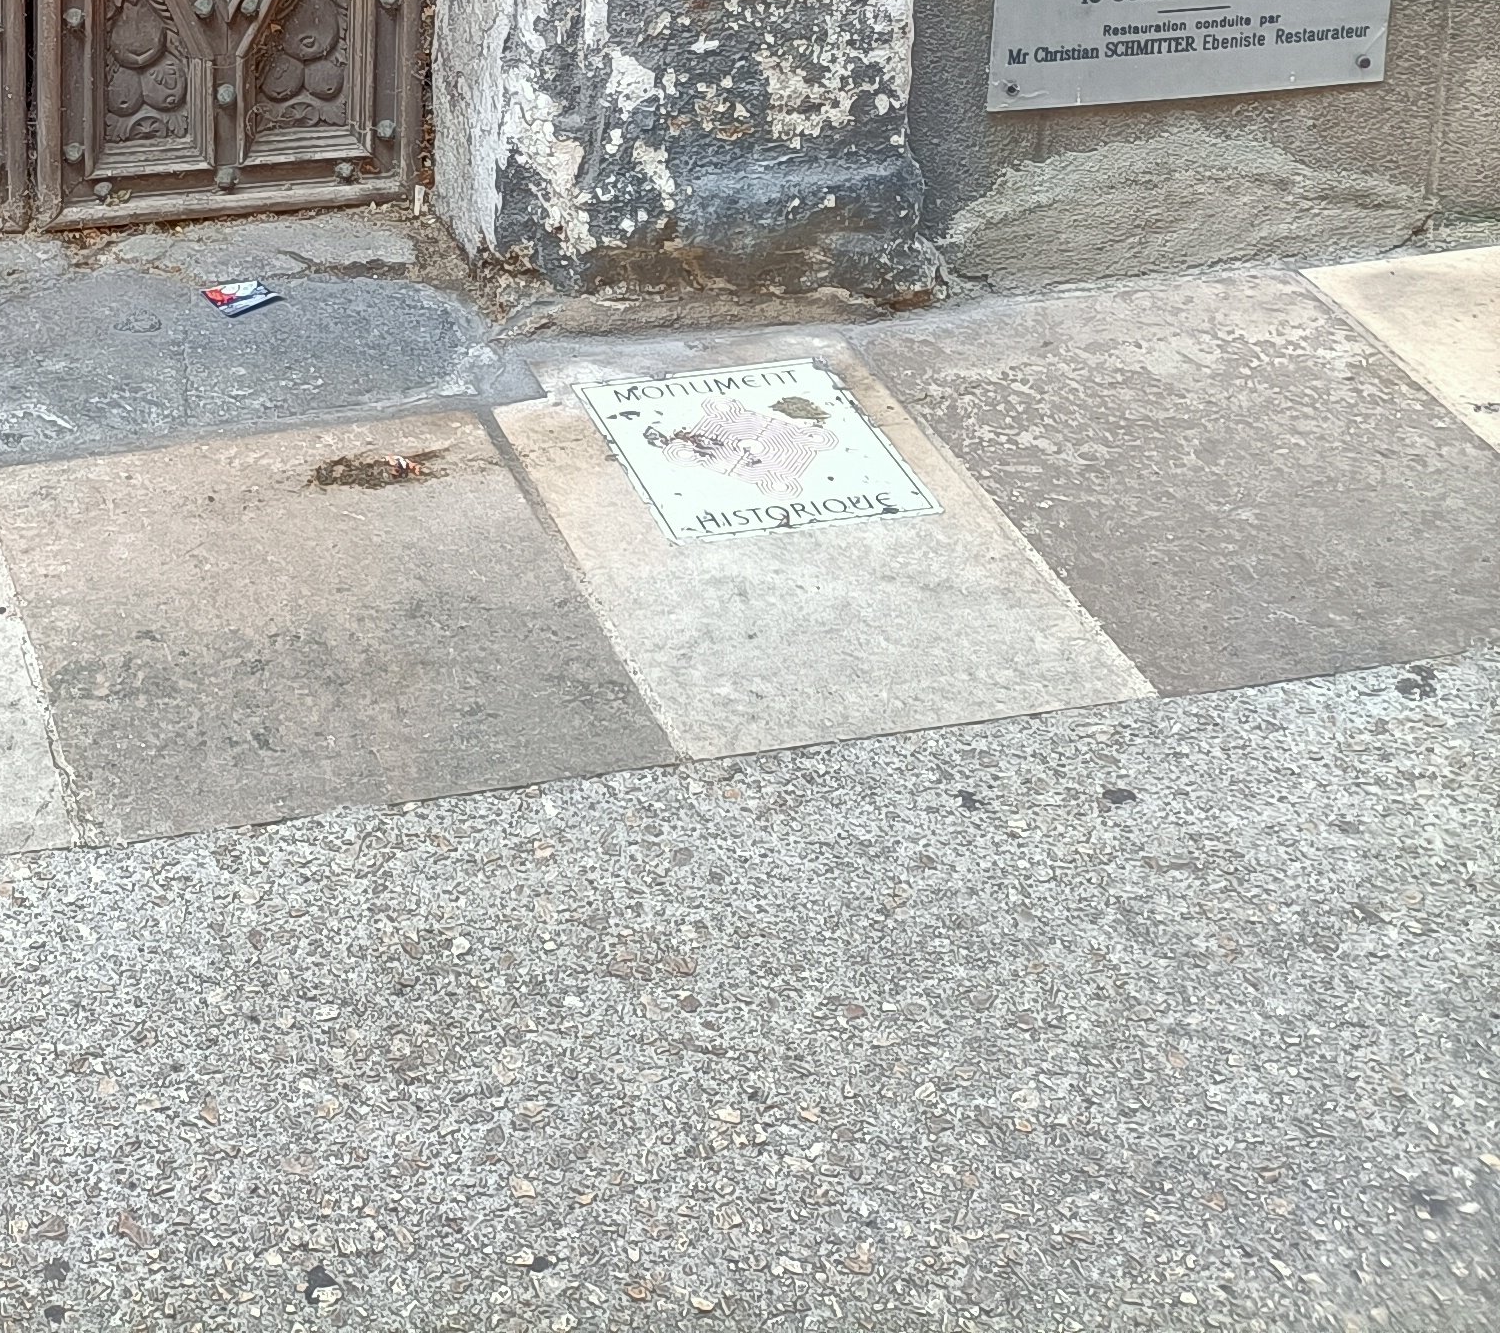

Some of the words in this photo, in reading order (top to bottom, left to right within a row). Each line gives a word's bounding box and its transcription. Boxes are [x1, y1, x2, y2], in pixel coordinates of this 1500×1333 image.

[1103, 20, 1187, 37] Restauration
[1195, 15, 1251, 30] conduite
[1259, 14, 1281, 28] par
[1007, 48, 1030, 65] Mr
[1034, 44, 1100, 63] Christian
[1104, 36, 1197, 58] SCHMITTER
[1203, 31, 1266, 51] Ebeniste
[1275, 25, 1370, 45] Restaurateur
[613, 369, 799, 404] MONUMENT
[695, 492, 898, 530] HISTORIQUE
